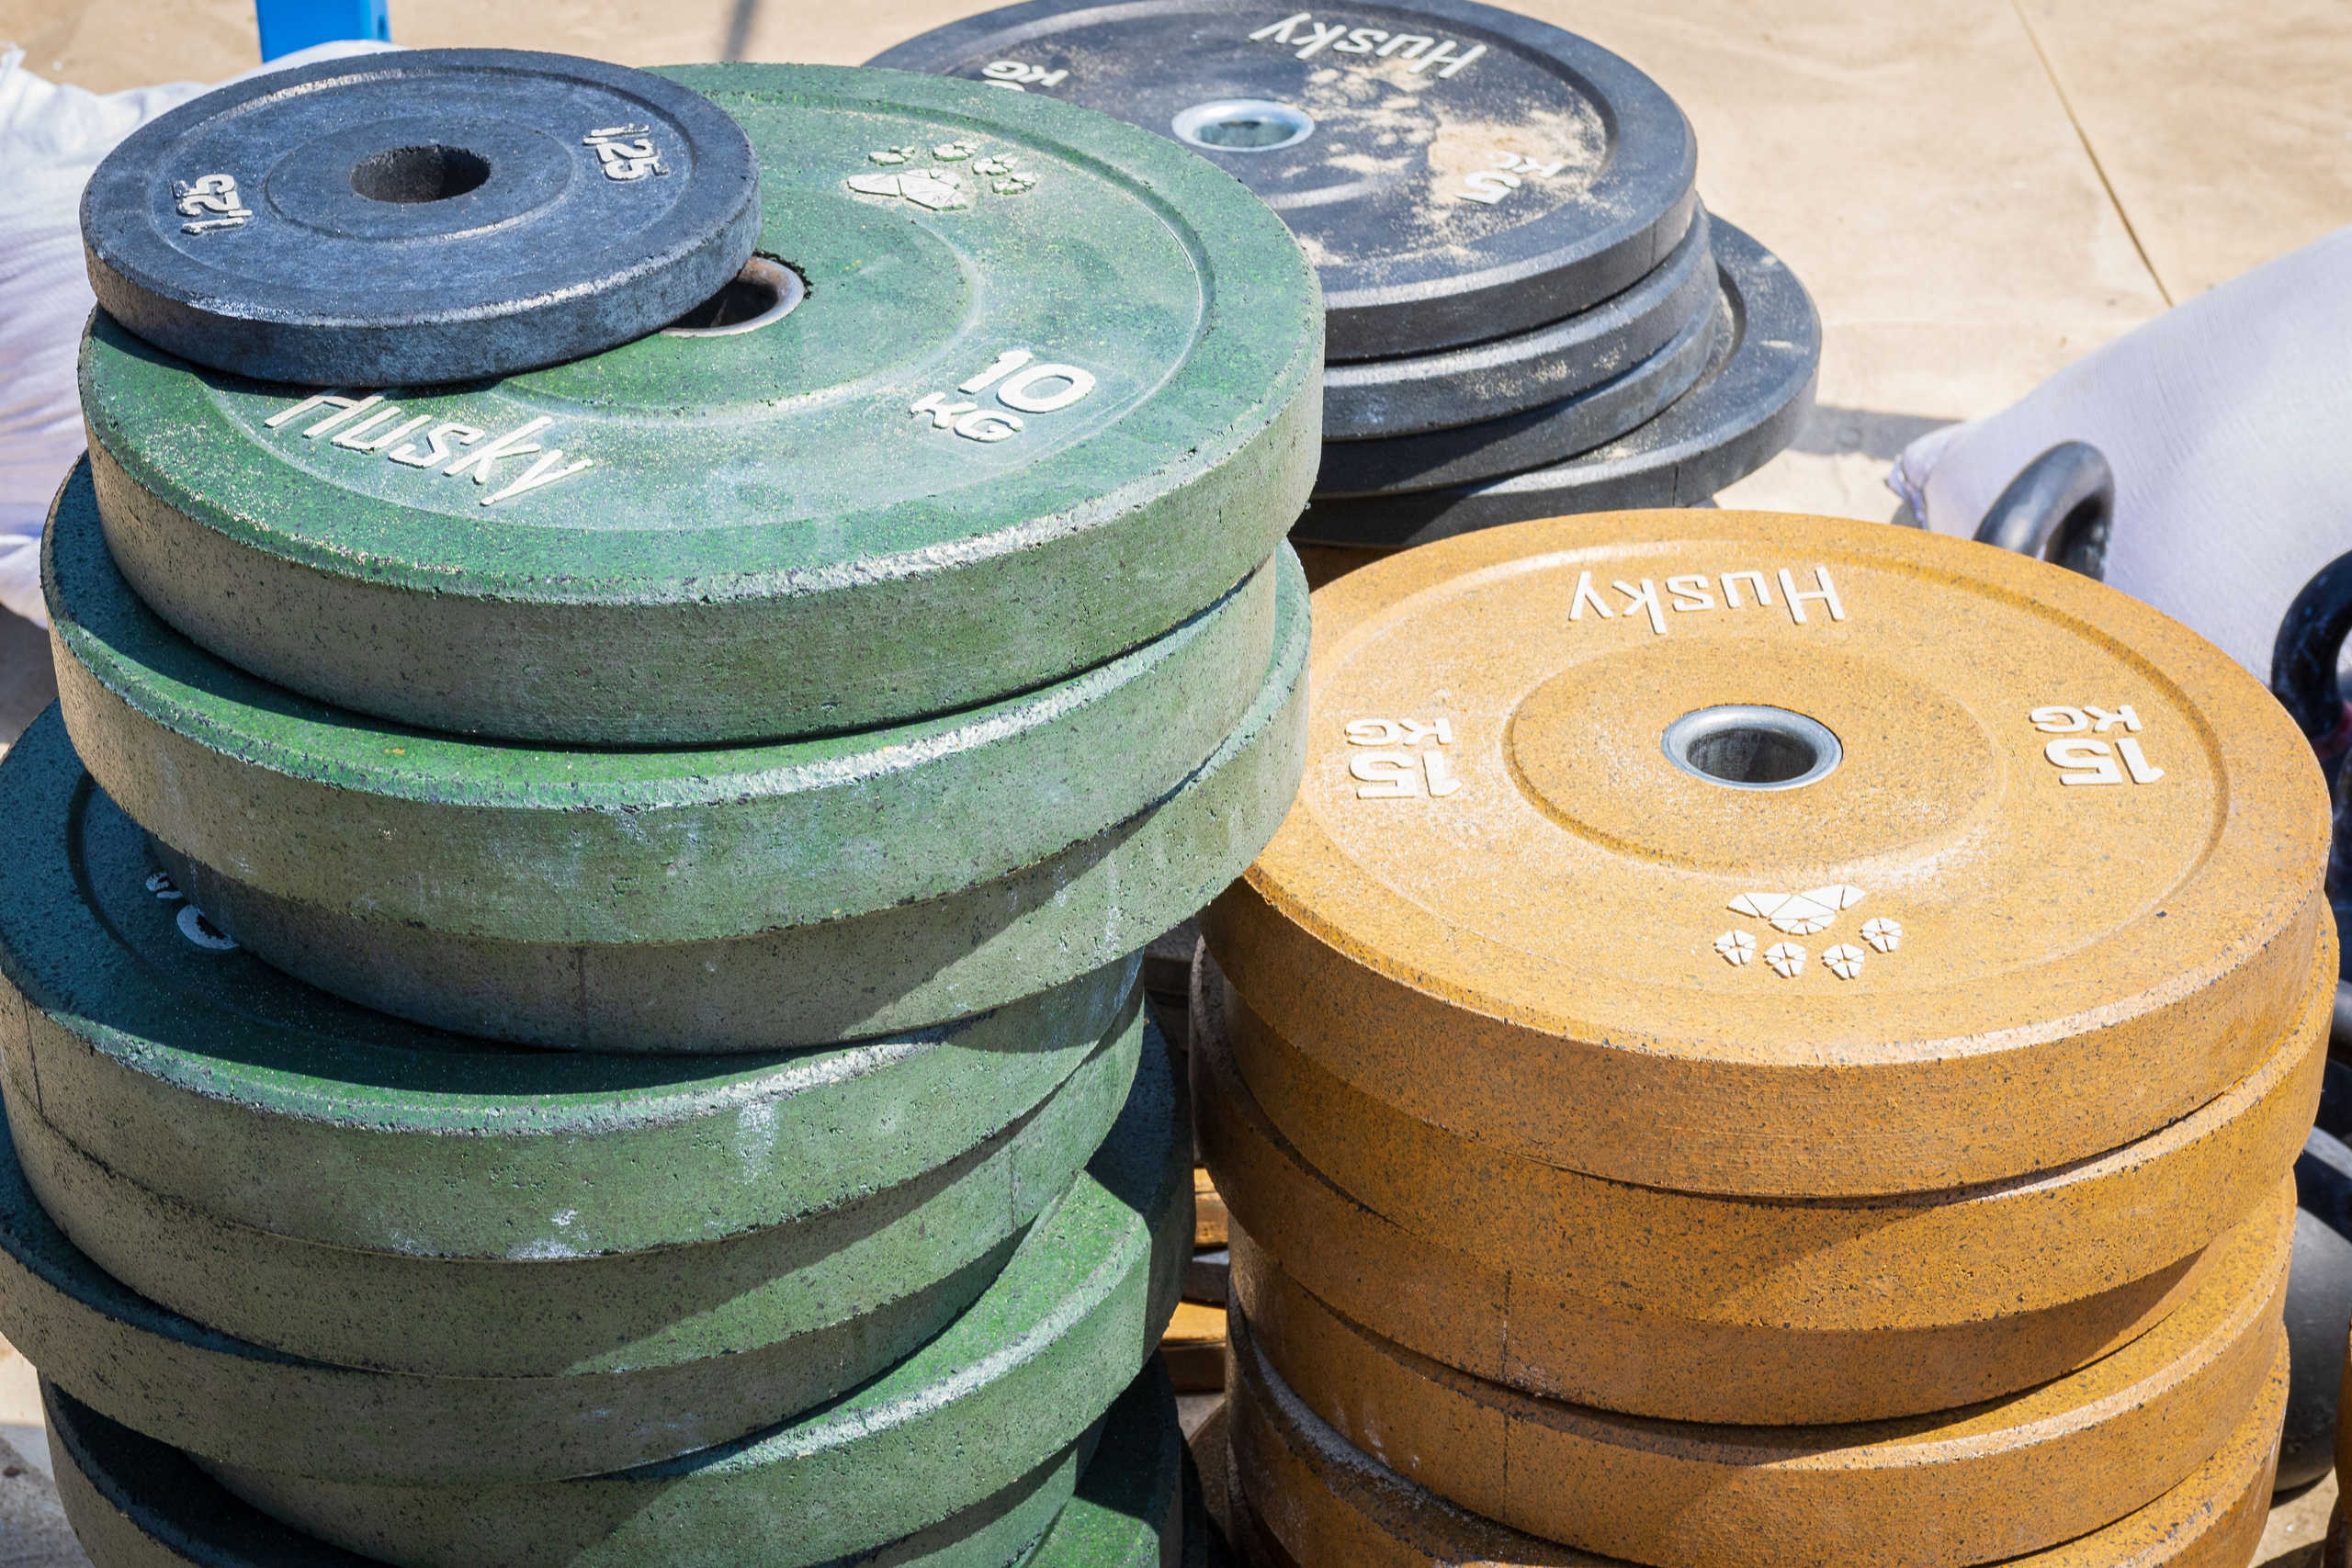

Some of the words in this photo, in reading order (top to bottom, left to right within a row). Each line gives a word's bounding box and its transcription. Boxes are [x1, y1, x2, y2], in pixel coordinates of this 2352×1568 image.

[1248, 12, 1487, 79] Husky
[981, 60, 1069, 87] KG
[1453, 171, 1521, 205] 5
[957, 349, 1096, 413] 10
[910, 391, 1024, 443] KG
[264, 388, 594, 505] Husky
[1568, 566, 1845, 635] Husky
[1344, 717, 1453, 747] KG
[2029, 705, 2143, 733] KG
[1349, 750, 1463, 799] 15
[2043, 738, 2165, 785] 15
